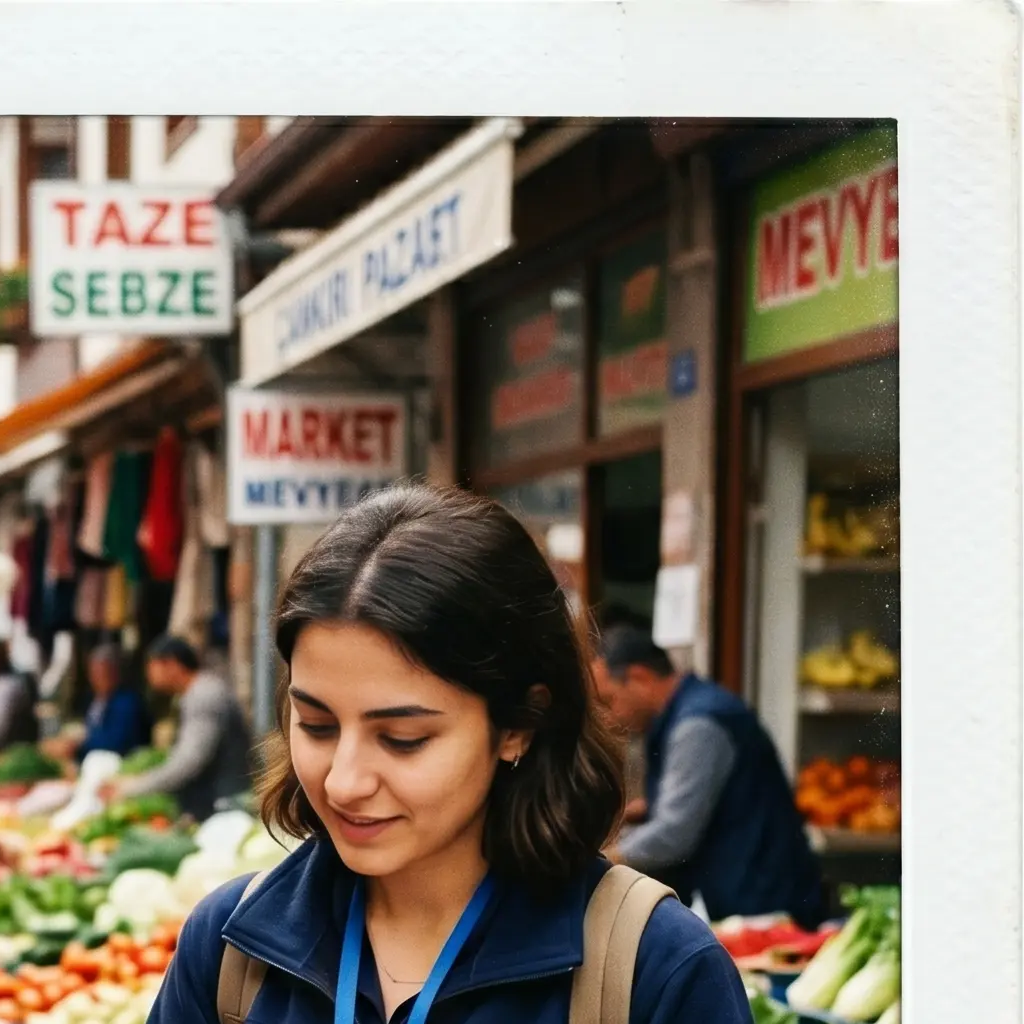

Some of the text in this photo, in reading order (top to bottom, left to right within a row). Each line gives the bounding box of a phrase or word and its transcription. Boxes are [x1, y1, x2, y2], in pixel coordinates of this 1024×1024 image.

[53, 199, 215, 249] TAZE
[50, 269, 215, 318] SEBZE
[242, 405, 400, 464] MARKET
